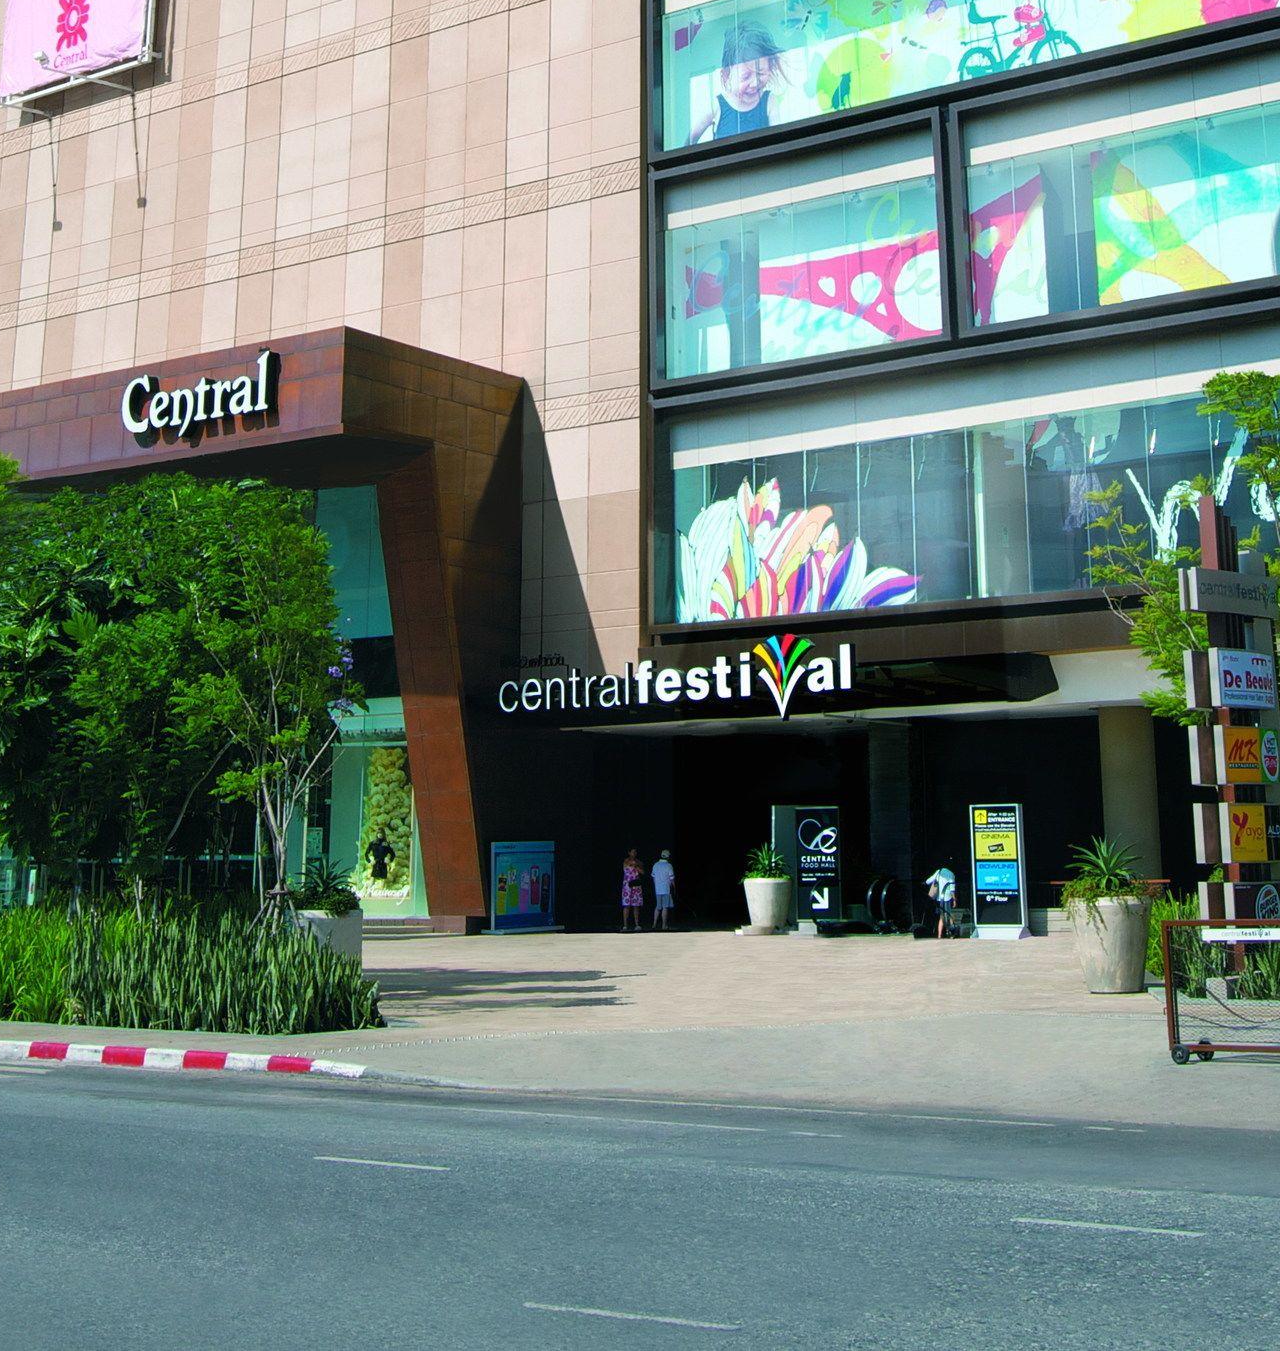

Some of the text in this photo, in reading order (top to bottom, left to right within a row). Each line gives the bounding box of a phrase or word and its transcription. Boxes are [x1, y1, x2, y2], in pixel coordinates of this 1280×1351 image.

[121, 351, 270, 437] Central
[499, 642, 852, 718] centralfestival
[1223, 669, 1242, 688] De
[1228, 738, 1259, 762] MK
[801, 855, 835, 863] CENTRAL
